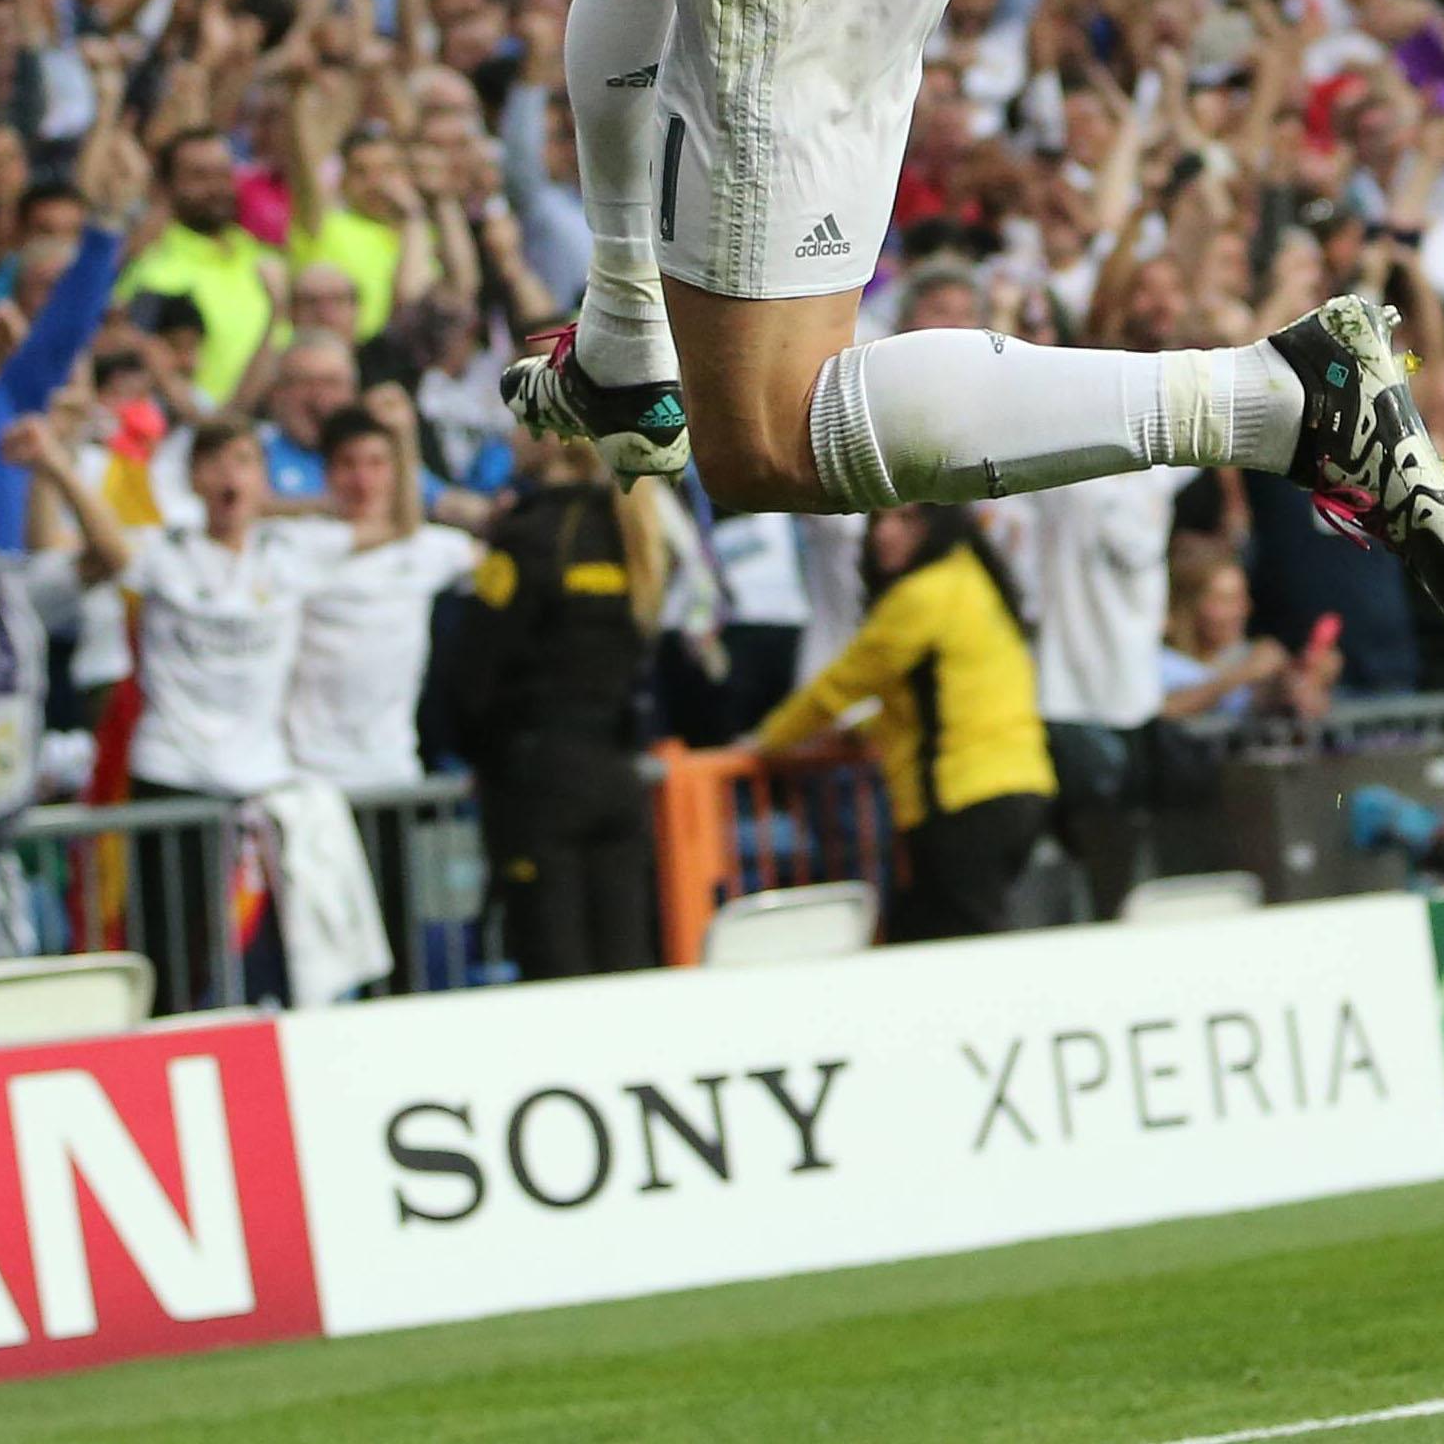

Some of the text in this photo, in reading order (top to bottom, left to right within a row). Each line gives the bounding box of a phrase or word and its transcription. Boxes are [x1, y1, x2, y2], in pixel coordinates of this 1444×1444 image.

[794, 240, 851, 258] adidas
[384, 1057, 851, 1225] SONY
[961, 998, 1390, 1153] XPERIA
